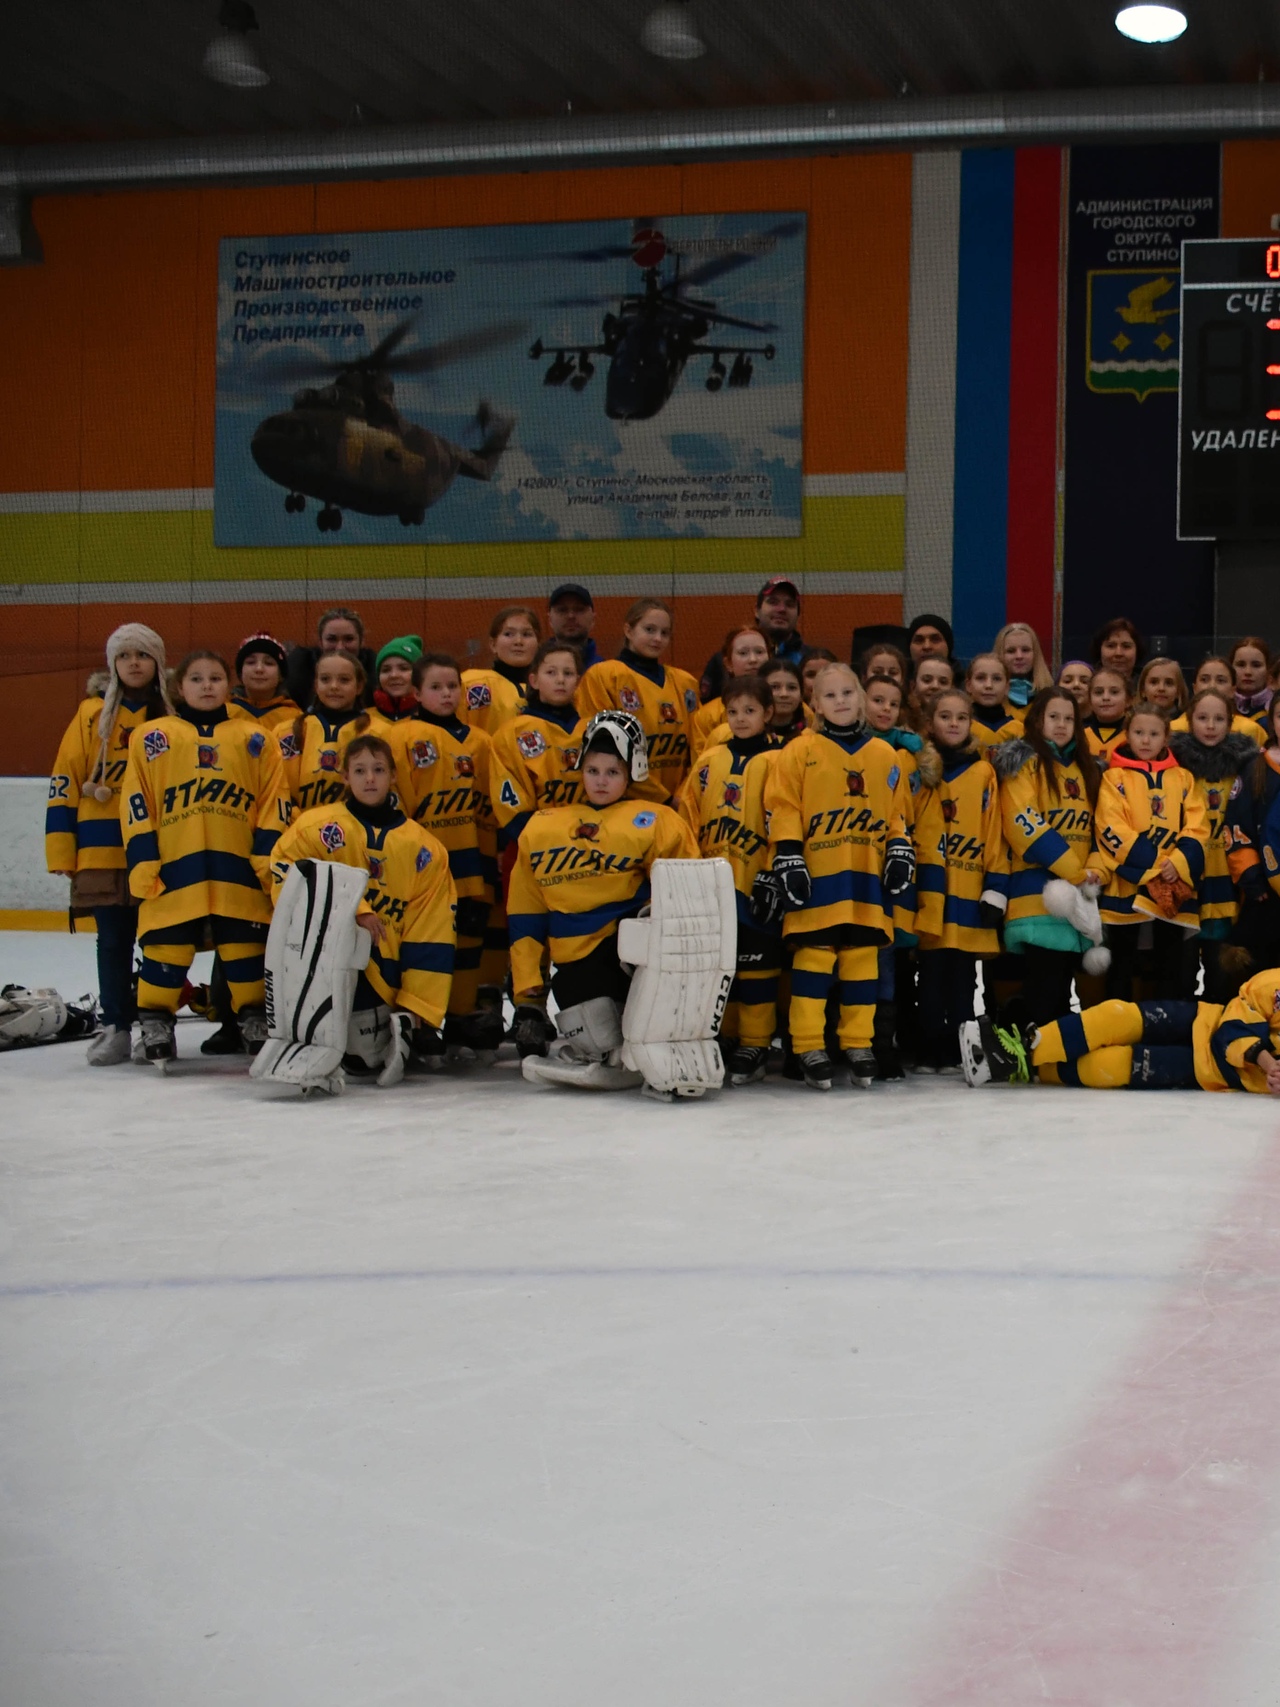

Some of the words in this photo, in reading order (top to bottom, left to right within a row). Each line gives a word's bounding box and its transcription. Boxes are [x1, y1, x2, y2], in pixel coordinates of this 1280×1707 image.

[1076, 198, 1213, 215] АДМИНИСТРАЦИЯ
[1093, 215, 1196, 229] ГОРОДСКОГО
[1115, 232, 1172, 245] ОКРУГА
[235, 249, 351, 270] Ступинское
[1106, 248, 1179, 262] СТУПИНО
[234, 269, 456, 292] Машиностроительное
[234, 294, 423, 319] Производственное
[233, 322, 365, 344] Предприятие
[635, 474, 712, 486] Московская
[567, 495, 604, 506] улица
[608, 492, 677, 503] Академика
[500, 779, 520, 806] 4
[264, 968, 277, 1029] VAUGHN
[710, 974, 732, 1034] CCM
[564, 1026, 584, 1039] CCM
